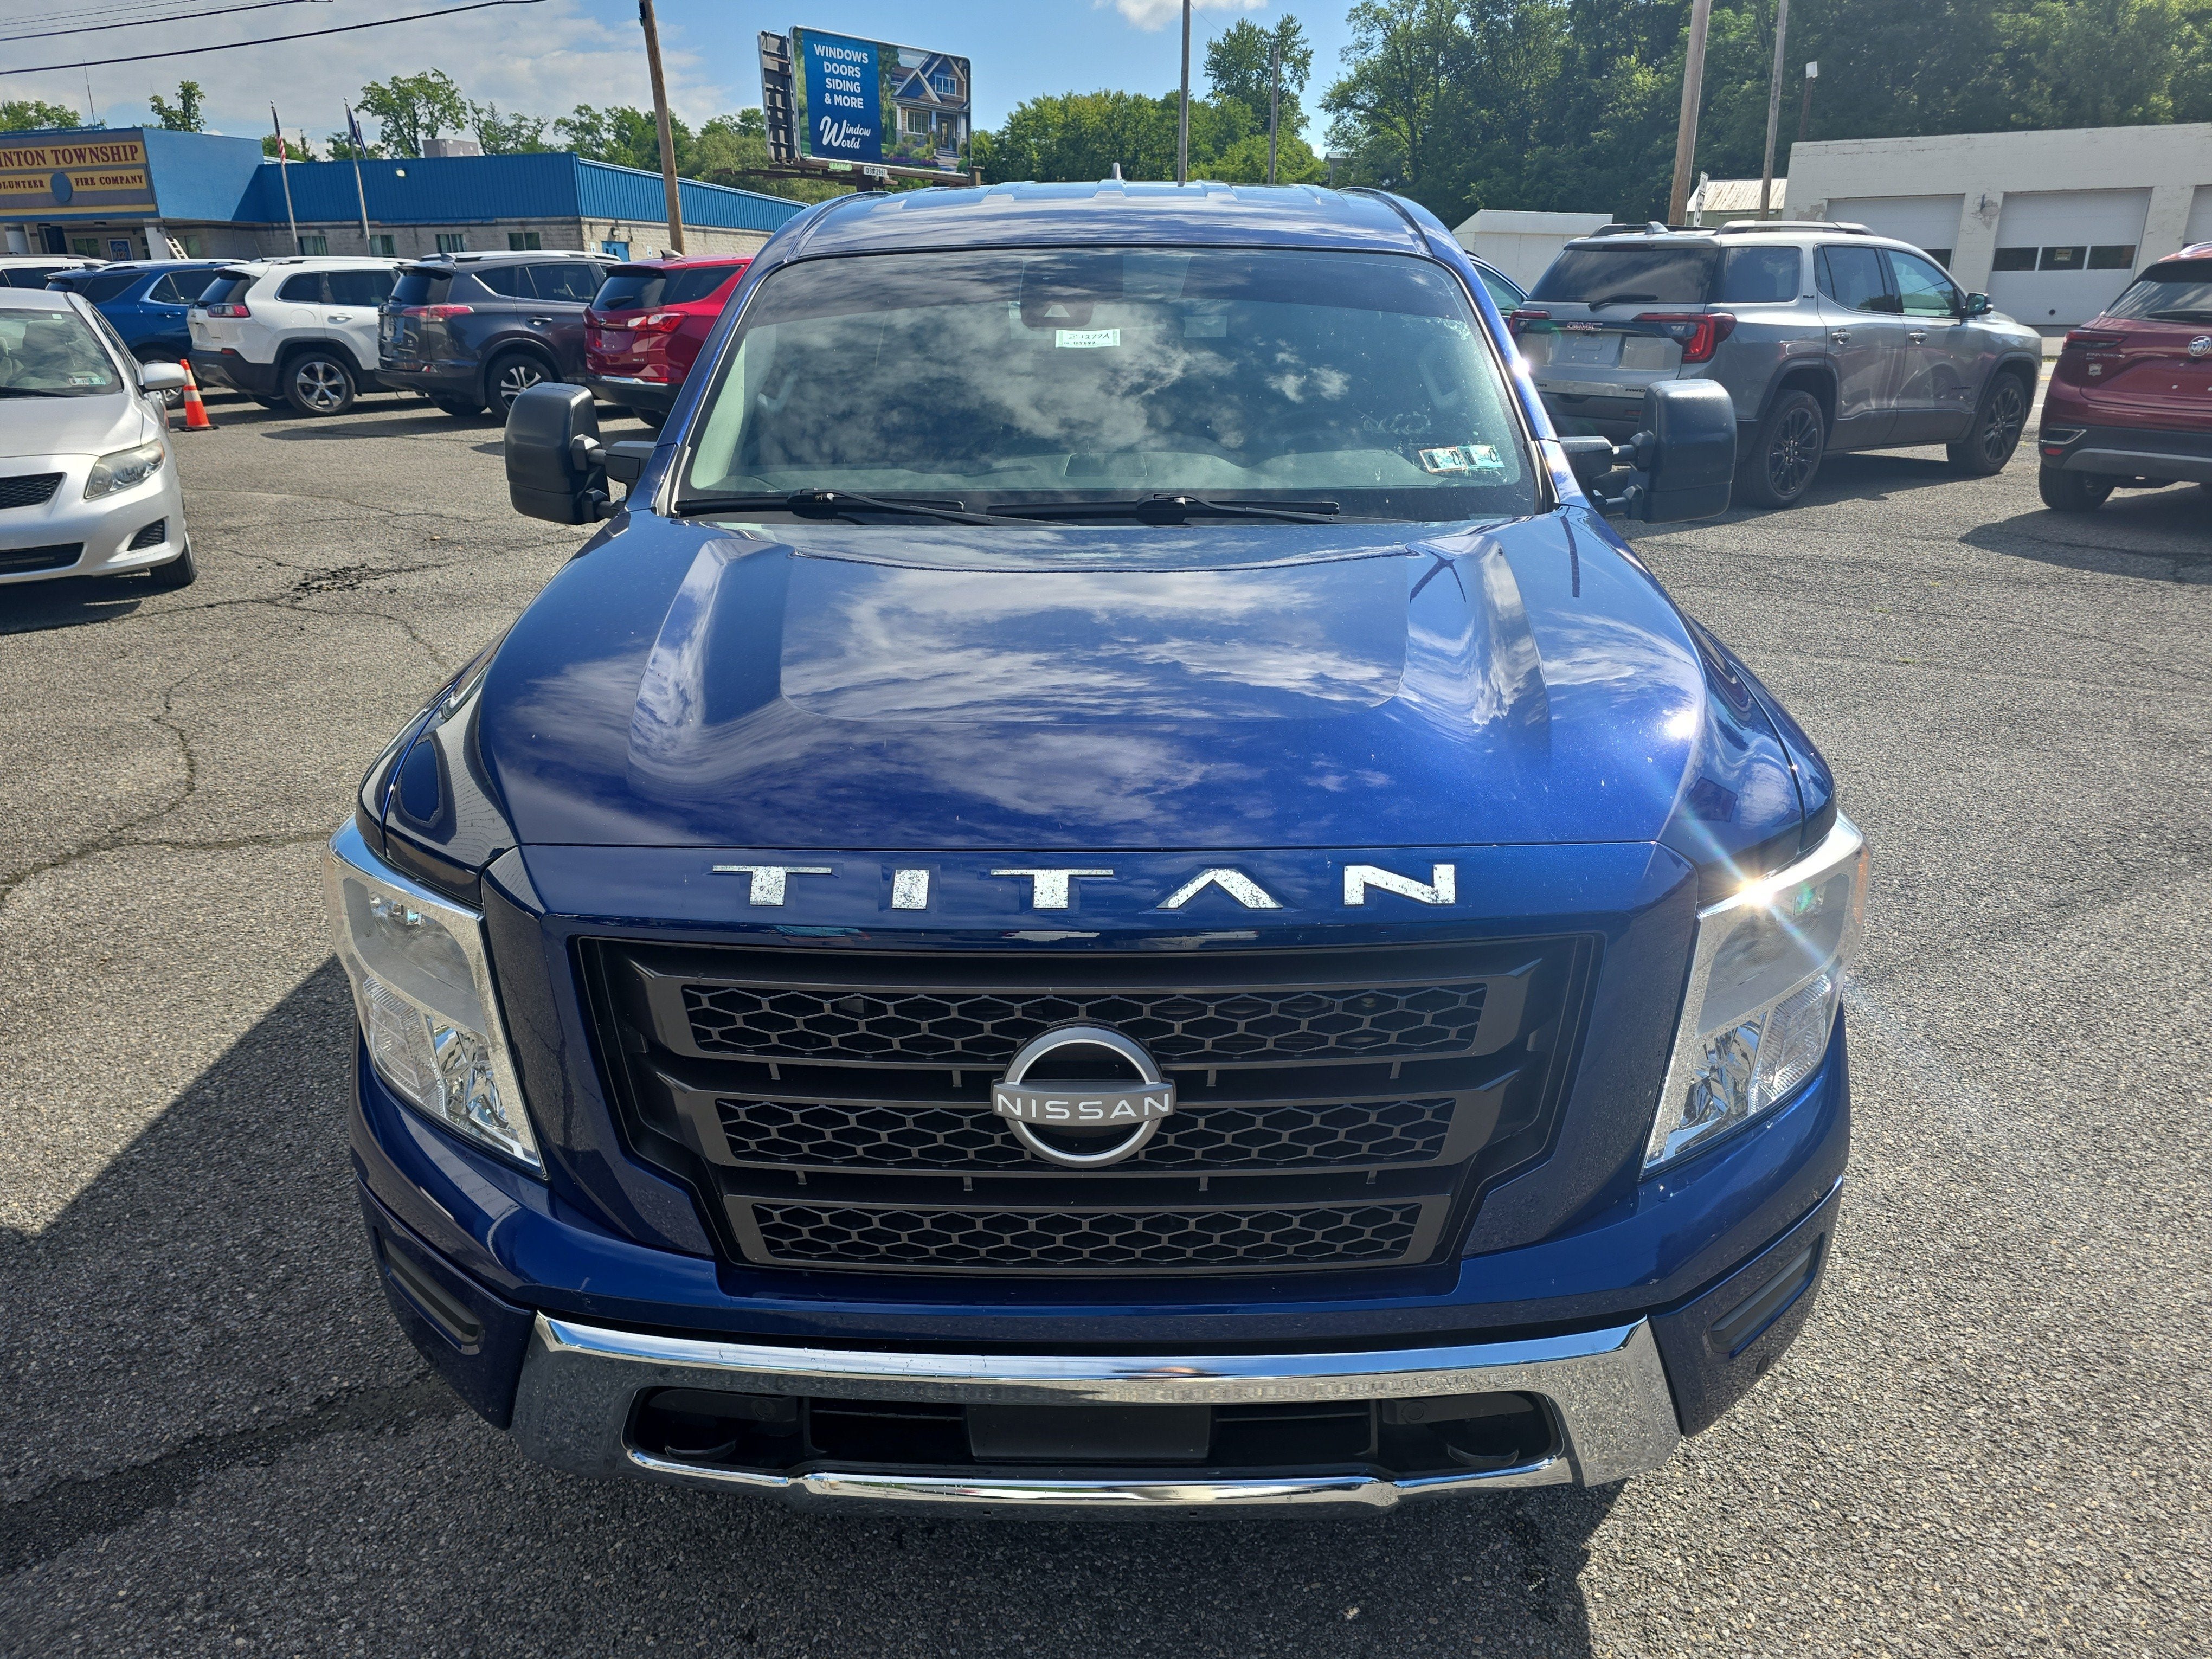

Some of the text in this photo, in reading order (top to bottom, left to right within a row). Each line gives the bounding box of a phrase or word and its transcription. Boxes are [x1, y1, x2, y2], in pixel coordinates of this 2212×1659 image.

[814, 43, 869, 64] WINDOWS
[824, 61, 861, 78] DOORS
[825, 78, 861, 93] SIDING
[824, 93, 864, 109] & MORE
[819, 115, 871, 147] Window
[51, 145, 138, 165] TOWNSHIP
[74, 177, 95, 186] FIRE
[99, 175, 143, 184] COMPANY
[1566, 321, 1603, 331] GMC
[712, 863, 1456, 909] TITAN
[997, 1093, 1169, 1120] NISSAN
